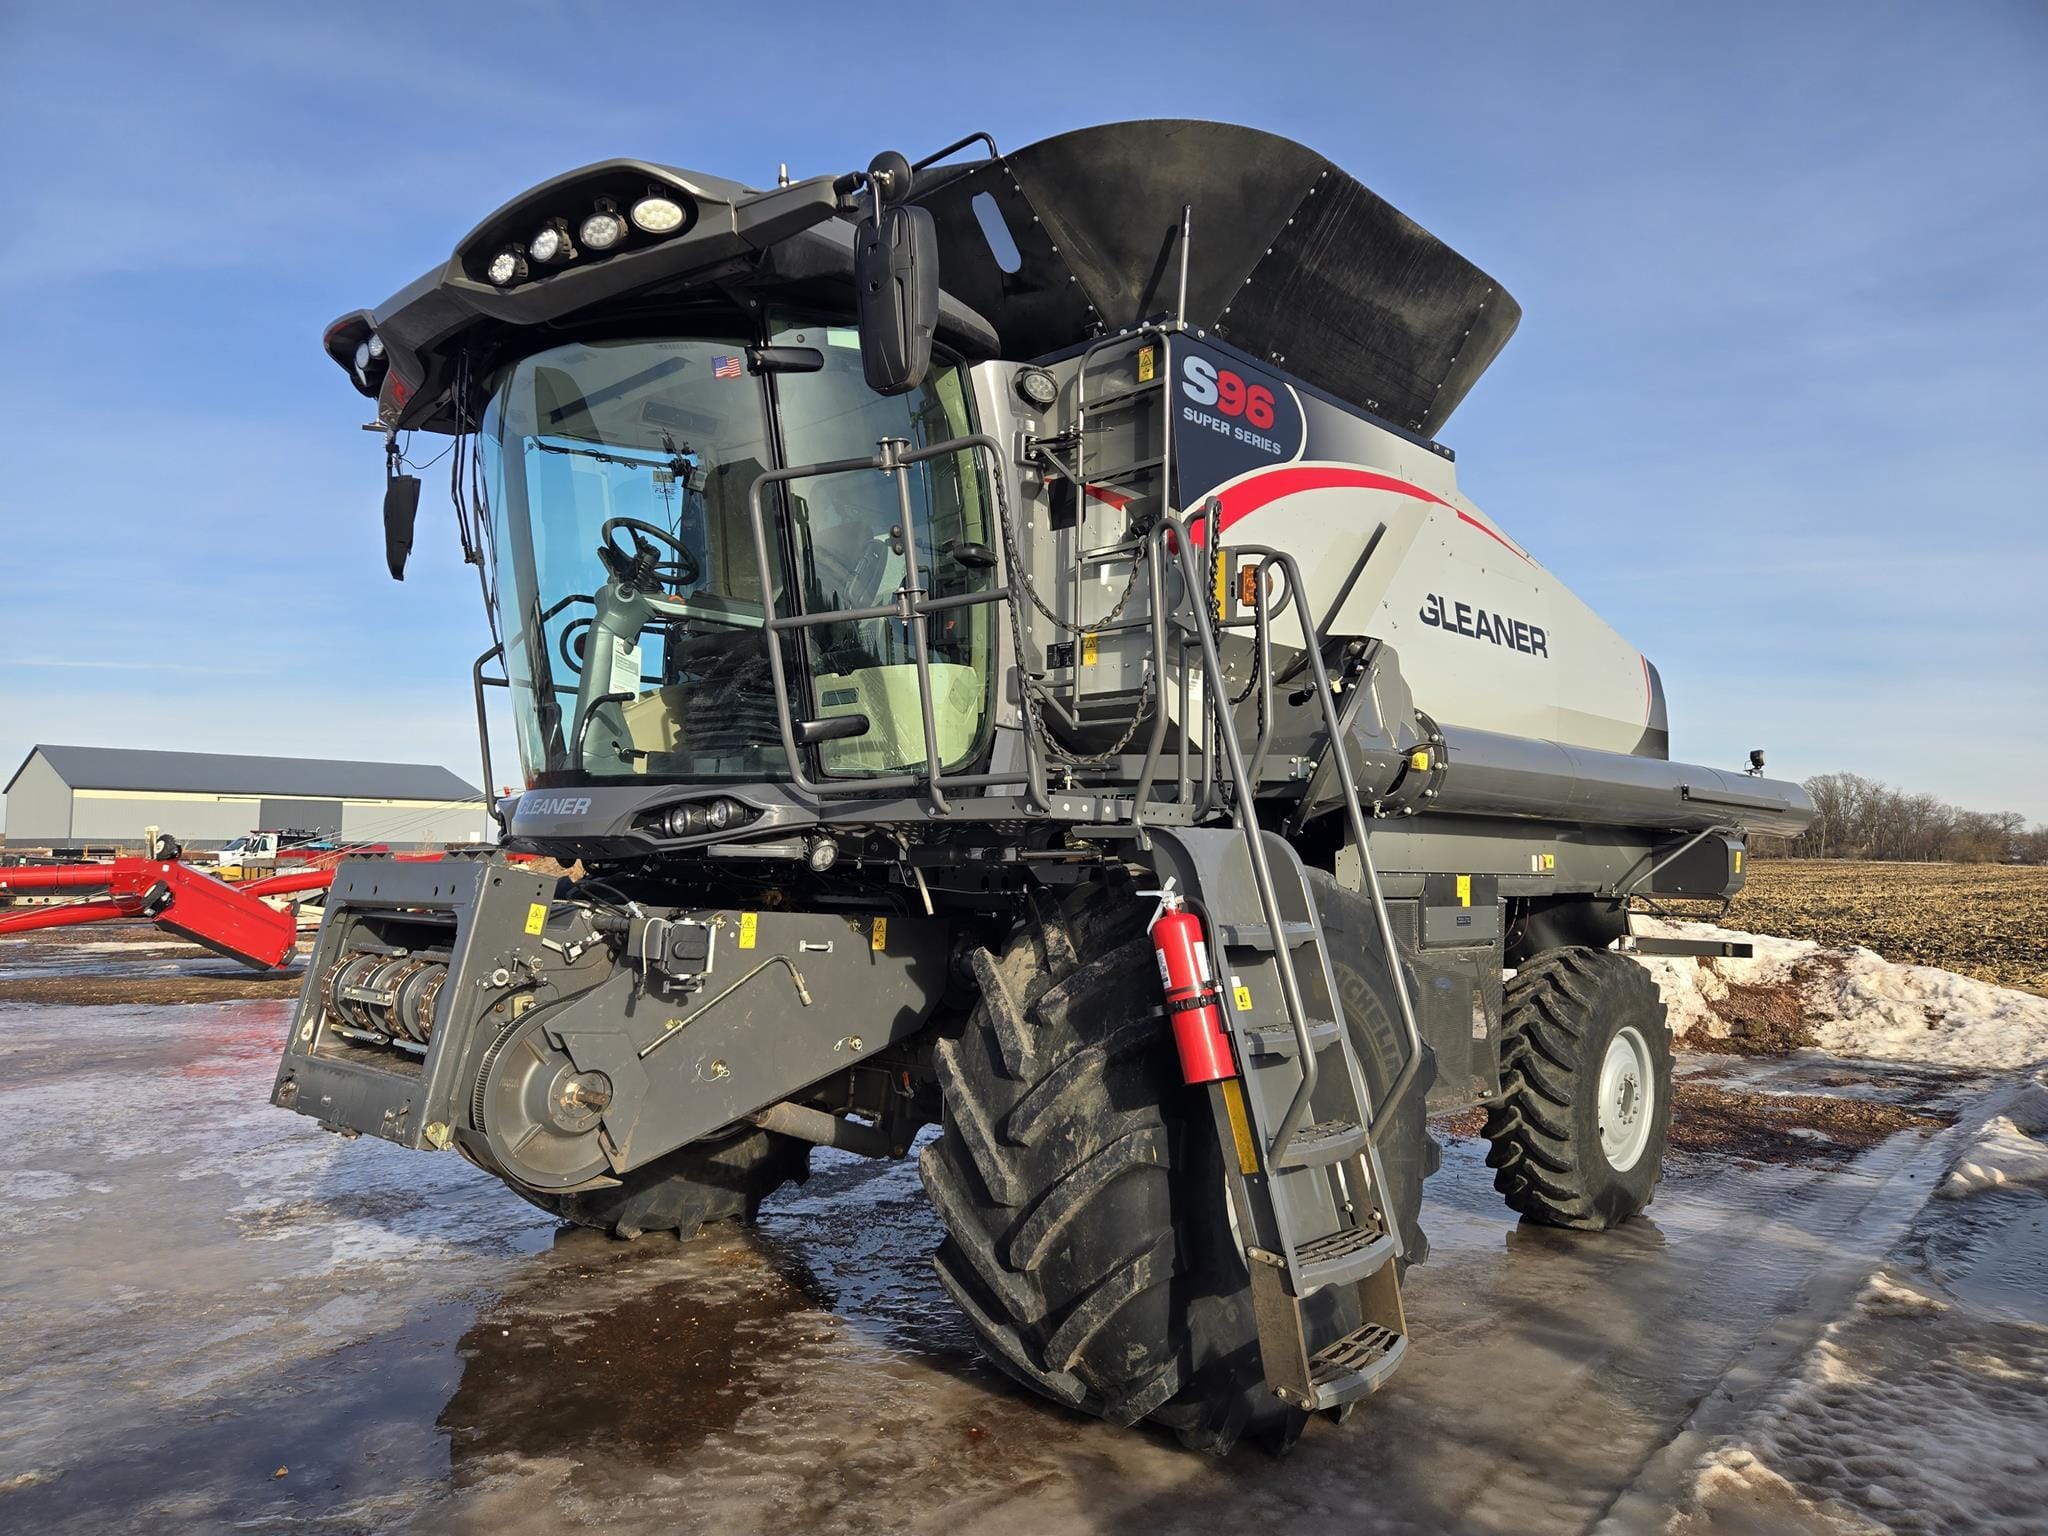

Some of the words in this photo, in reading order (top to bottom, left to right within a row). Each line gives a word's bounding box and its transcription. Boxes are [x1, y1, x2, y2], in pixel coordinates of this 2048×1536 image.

[1182, 355, 1276, 430] S96
[1183, 407, 1231, 436] SUPER
[1234, 427, 1281, 455] SERIES
[1419, 592, 1548, 659] GLEANER
[519, 797, 592, 815] GLEANER
